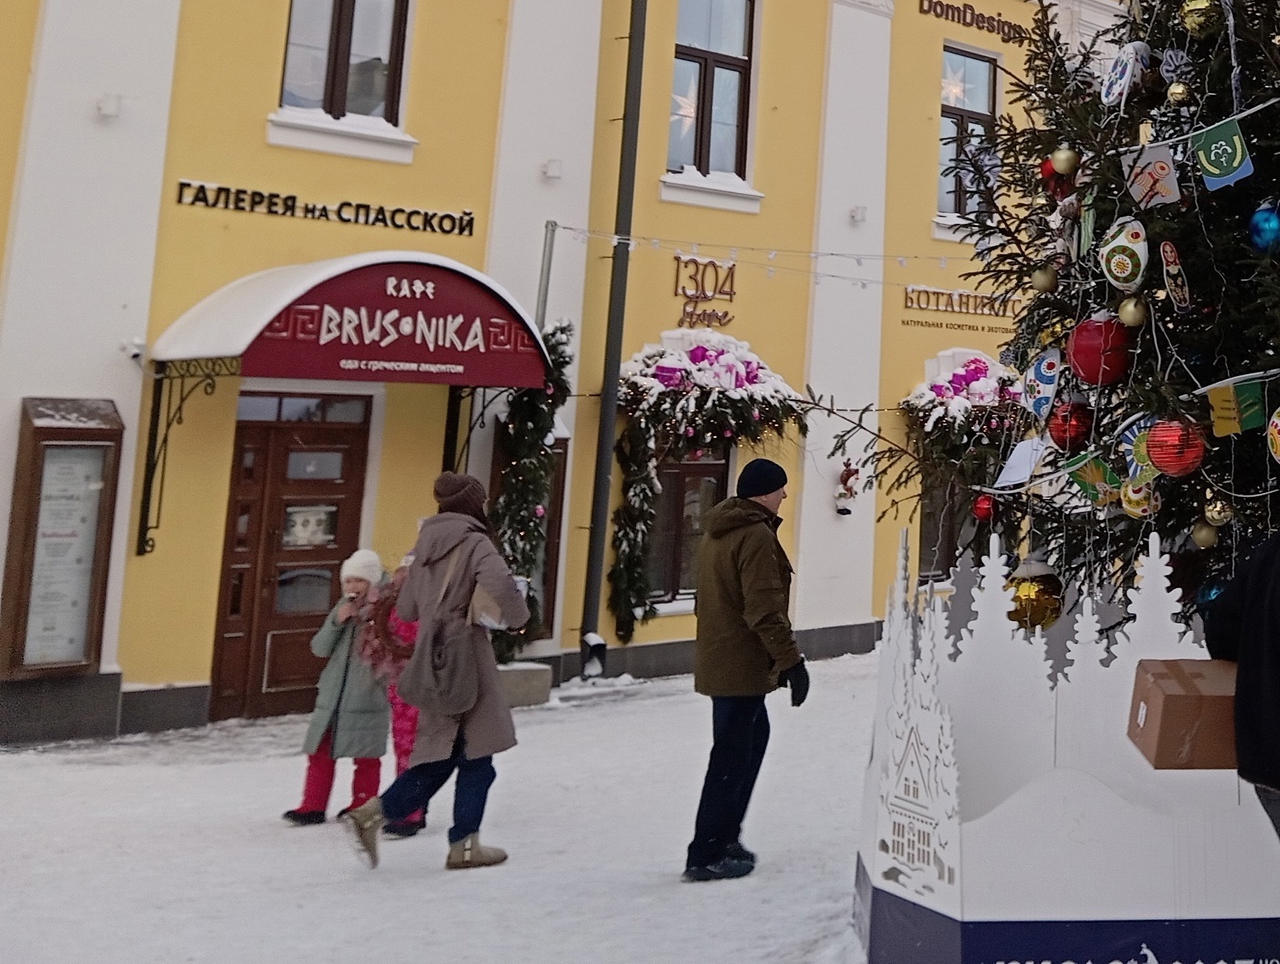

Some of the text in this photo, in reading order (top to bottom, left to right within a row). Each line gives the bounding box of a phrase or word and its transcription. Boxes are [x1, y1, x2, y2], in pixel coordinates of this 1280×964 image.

[176, 181, 475, 237] ГАЛЕРЕЯ НА СПАССКОЙ
[386, 276, 436, 299] КАФЕ
[674, 255, 736, 302] 1304
[901, 319, 943, 329] НАТУРАЛЬНАЯ
[945, 322, 979, 332] КОСМЕТИКА
[360, 360, 368, 370] с
